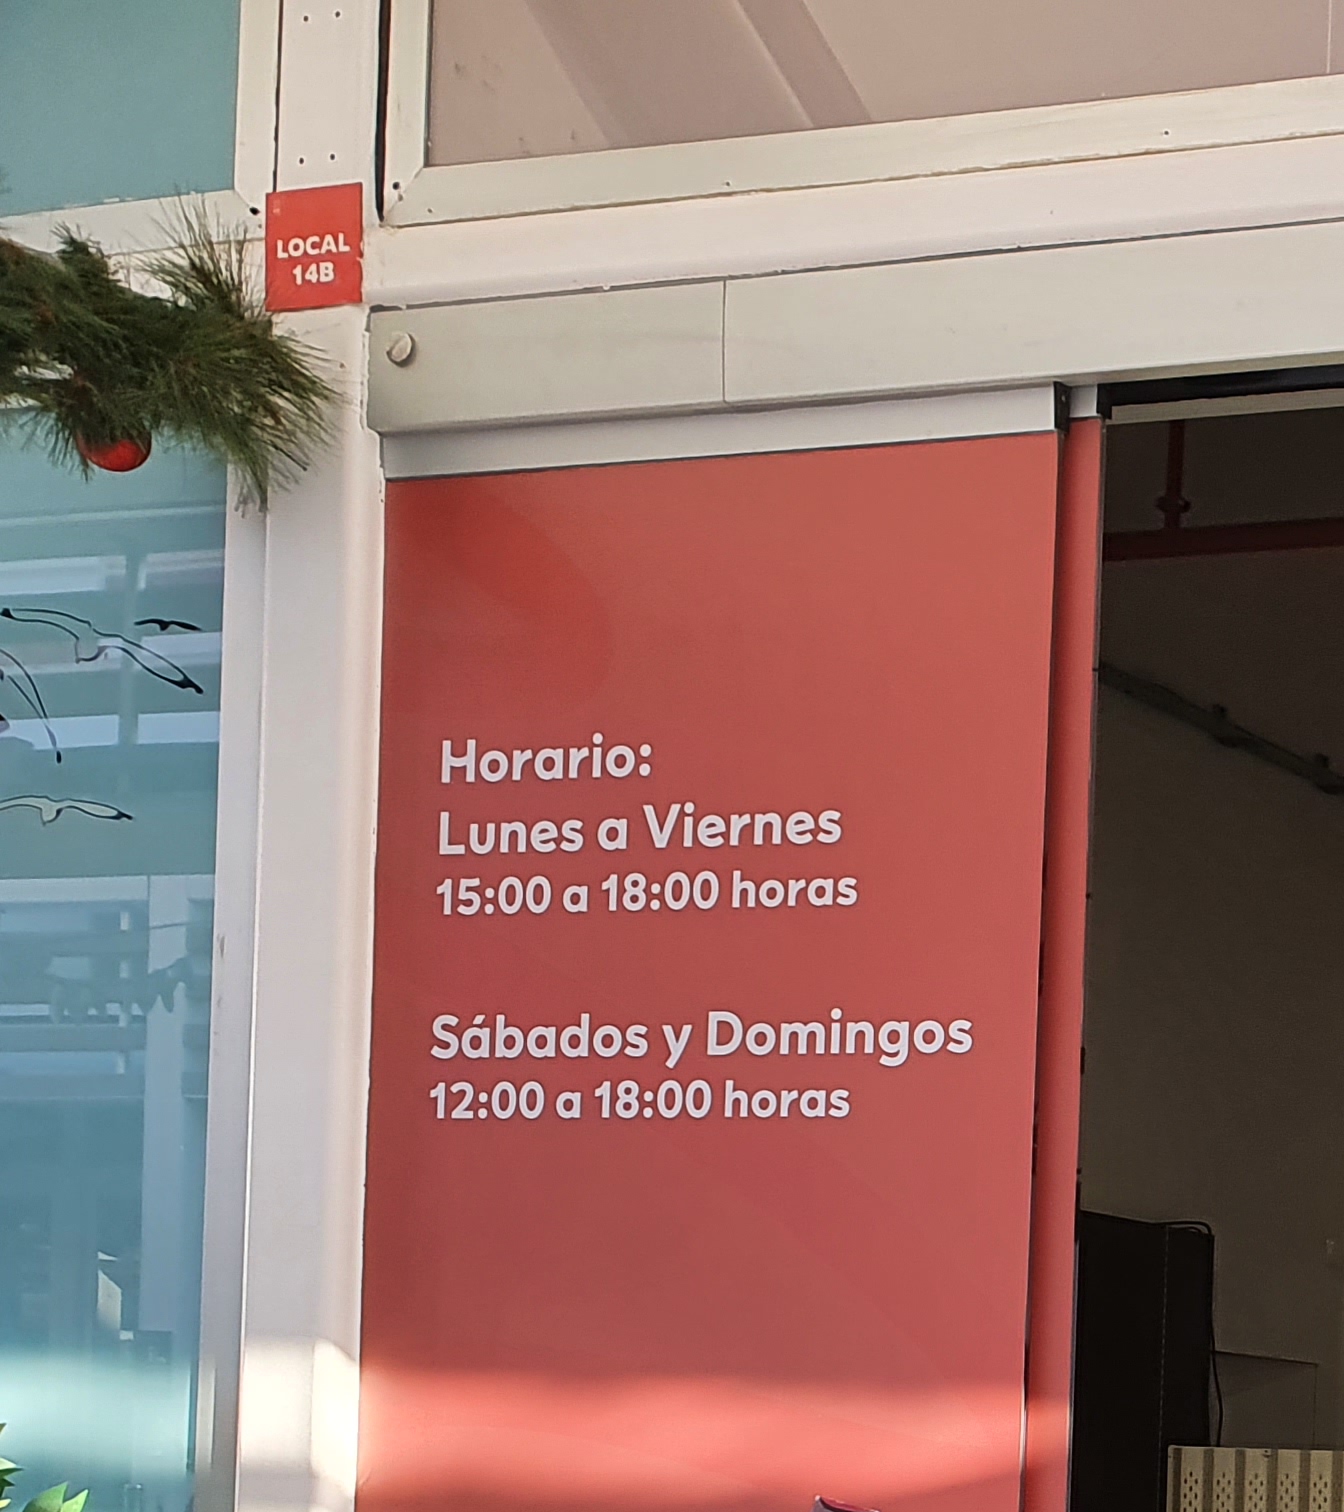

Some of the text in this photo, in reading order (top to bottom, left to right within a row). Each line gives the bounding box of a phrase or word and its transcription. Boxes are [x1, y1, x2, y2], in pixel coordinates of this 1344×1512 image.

[276, 232, 351, 259] LOCAL
[292, 261, 335, 285] 14B
[441, 732, 652, 784] Horario:
[439, 801, 842, 855] Lunes a Viernes
[436, 870, 858, 916] 15:00 a 18:00 horas
[430, 1007, 973, 1069] Sábados y Domingos
[429, 1079, 850, 1120] 12:00 a 18:00 horas
